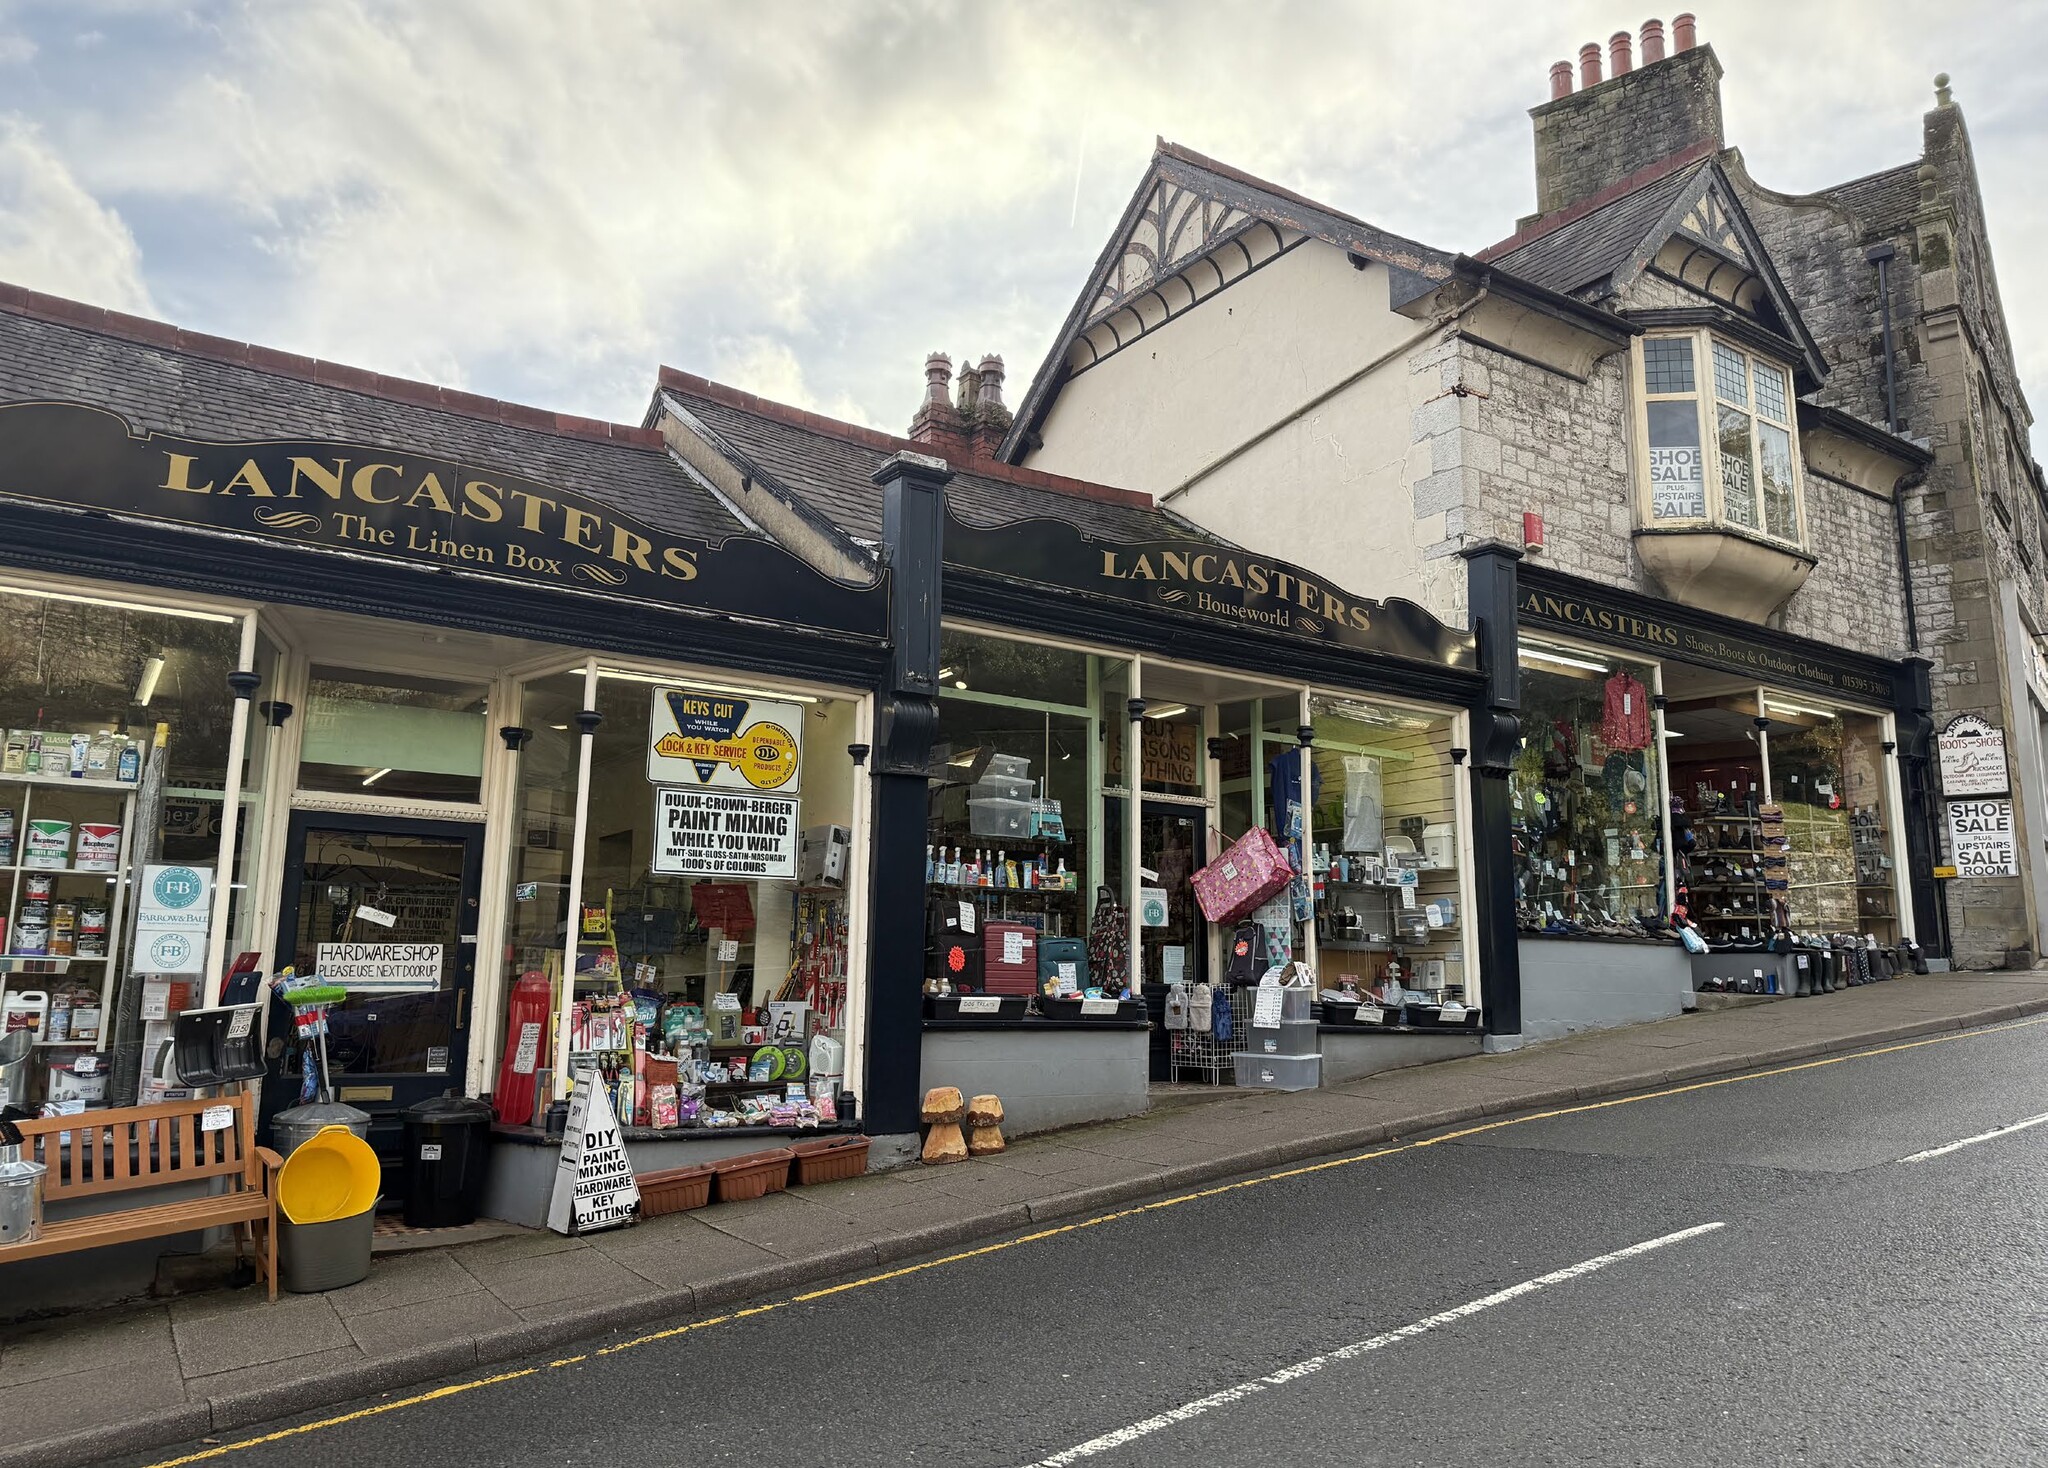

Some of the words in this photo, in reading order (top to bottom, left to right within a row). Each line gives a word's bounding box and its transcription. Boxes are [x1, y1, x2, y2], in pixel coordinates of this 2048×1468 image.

[1650, 450, 1700, 466] SHOE
[1651, 466, 1701, 482] SALE
[158, 450, 698, 581] LANCASTERS
[1726, 508, 1748, 524] ALE
[332, 511, 395, 546] The
[407, 525, 495, 564] Linen
[505, 542, 563, 576] Box
[1100, 549, 1372, 631] LANCASTERS
[1197, 590, 1290, 628] Houseworld
[1517, 592, 1678, 646] ANCASTERS
[1685, 633, 1717, 656] Shoes,
[1719, 641, 1746, 662] Boots
[1747, 650, 1757, 664] &
[1759, 653, 1797, 675] Outdoor
[1798, 662, 1835, 686] Clothing
[683, 699, 710, 717] KEYS
[713, 702, 734, 719] CUT
[686, 723, 702, 731] YOU
[704, 725, 730, 734] WATCH
[694, 718, 718, 727] WHILE
[1143, 719, 1175, 739] OUR
[1947, 716, 1993, 738] LANCASTER'S
[752, 736, 786, 747] DEPENDABLE
[765, 724, 794, 748] DOMINION
[1940, 739, 1968, 750] BOOTS
[1976, 736, 2004, 748] SHOES
[662, 739, 685, 752] LOCK
[686, 743, 693, 753] &
[694, 743, 711, 755] KEY
[713, 745, 748, 759] SERVICE
[758, 748, 776, 759] DL
[753, 761, 782, 772] PRODUCTS
[784, 760, 793, 777] LOCK
[665, 793, 793, 816] DULUX-CROWN-BERGER
[1951, 802, 2011, 819] SHOE
[668, 808, 722, 831] PAINT
[725, 813, 788, 836] MIXING
[1955, 817, 2009, 833] SALE
[32, 837, 65, 846] Macpherson
[83, 840, 115, 849] Macpherson
[672, 831, 715, 848] WHILE
[717, 834, 744, 850] YOU
[747, 836, 781, 852] WAIT
[1957, 841, 2011, 851] UPSTAIRS
[1973, 834, 1993, 842] PLUS
[681, 858, 712, 870] 1000's
[713, 860, 725, 871] OF
[726, 861, 767, 873] COLOURS
[1958, 850, 2012, 866] SALE
[1963, 865, 2009, 876] ROOM
[165, 881, 191, 895] F&B
[161, 945, 182, 957] F&B
[321, 944, 403, 961] HARDWARE
[402, 945, 440, 961] SHOP
[319, 964, 357, 978] PLEASE
[356, 965, 375, 978] USE
[376, 964, 402, 978] NEXT
[402, 965, 426, 978] DOOR
[426, 965, 438, 977] UP
[572, 1105, 583, 1117] DIY
[585, 1129, 616, 1149] DIY
[583, 1149, 621, 1166] PAINT
[579, 1160, 626, 1179] MIXING
[576, 1175, 632, 1197] HARDWARE
[592, 1194, 615, 1208] KEY
[578, 1203, 633, 1225] CUTTING
